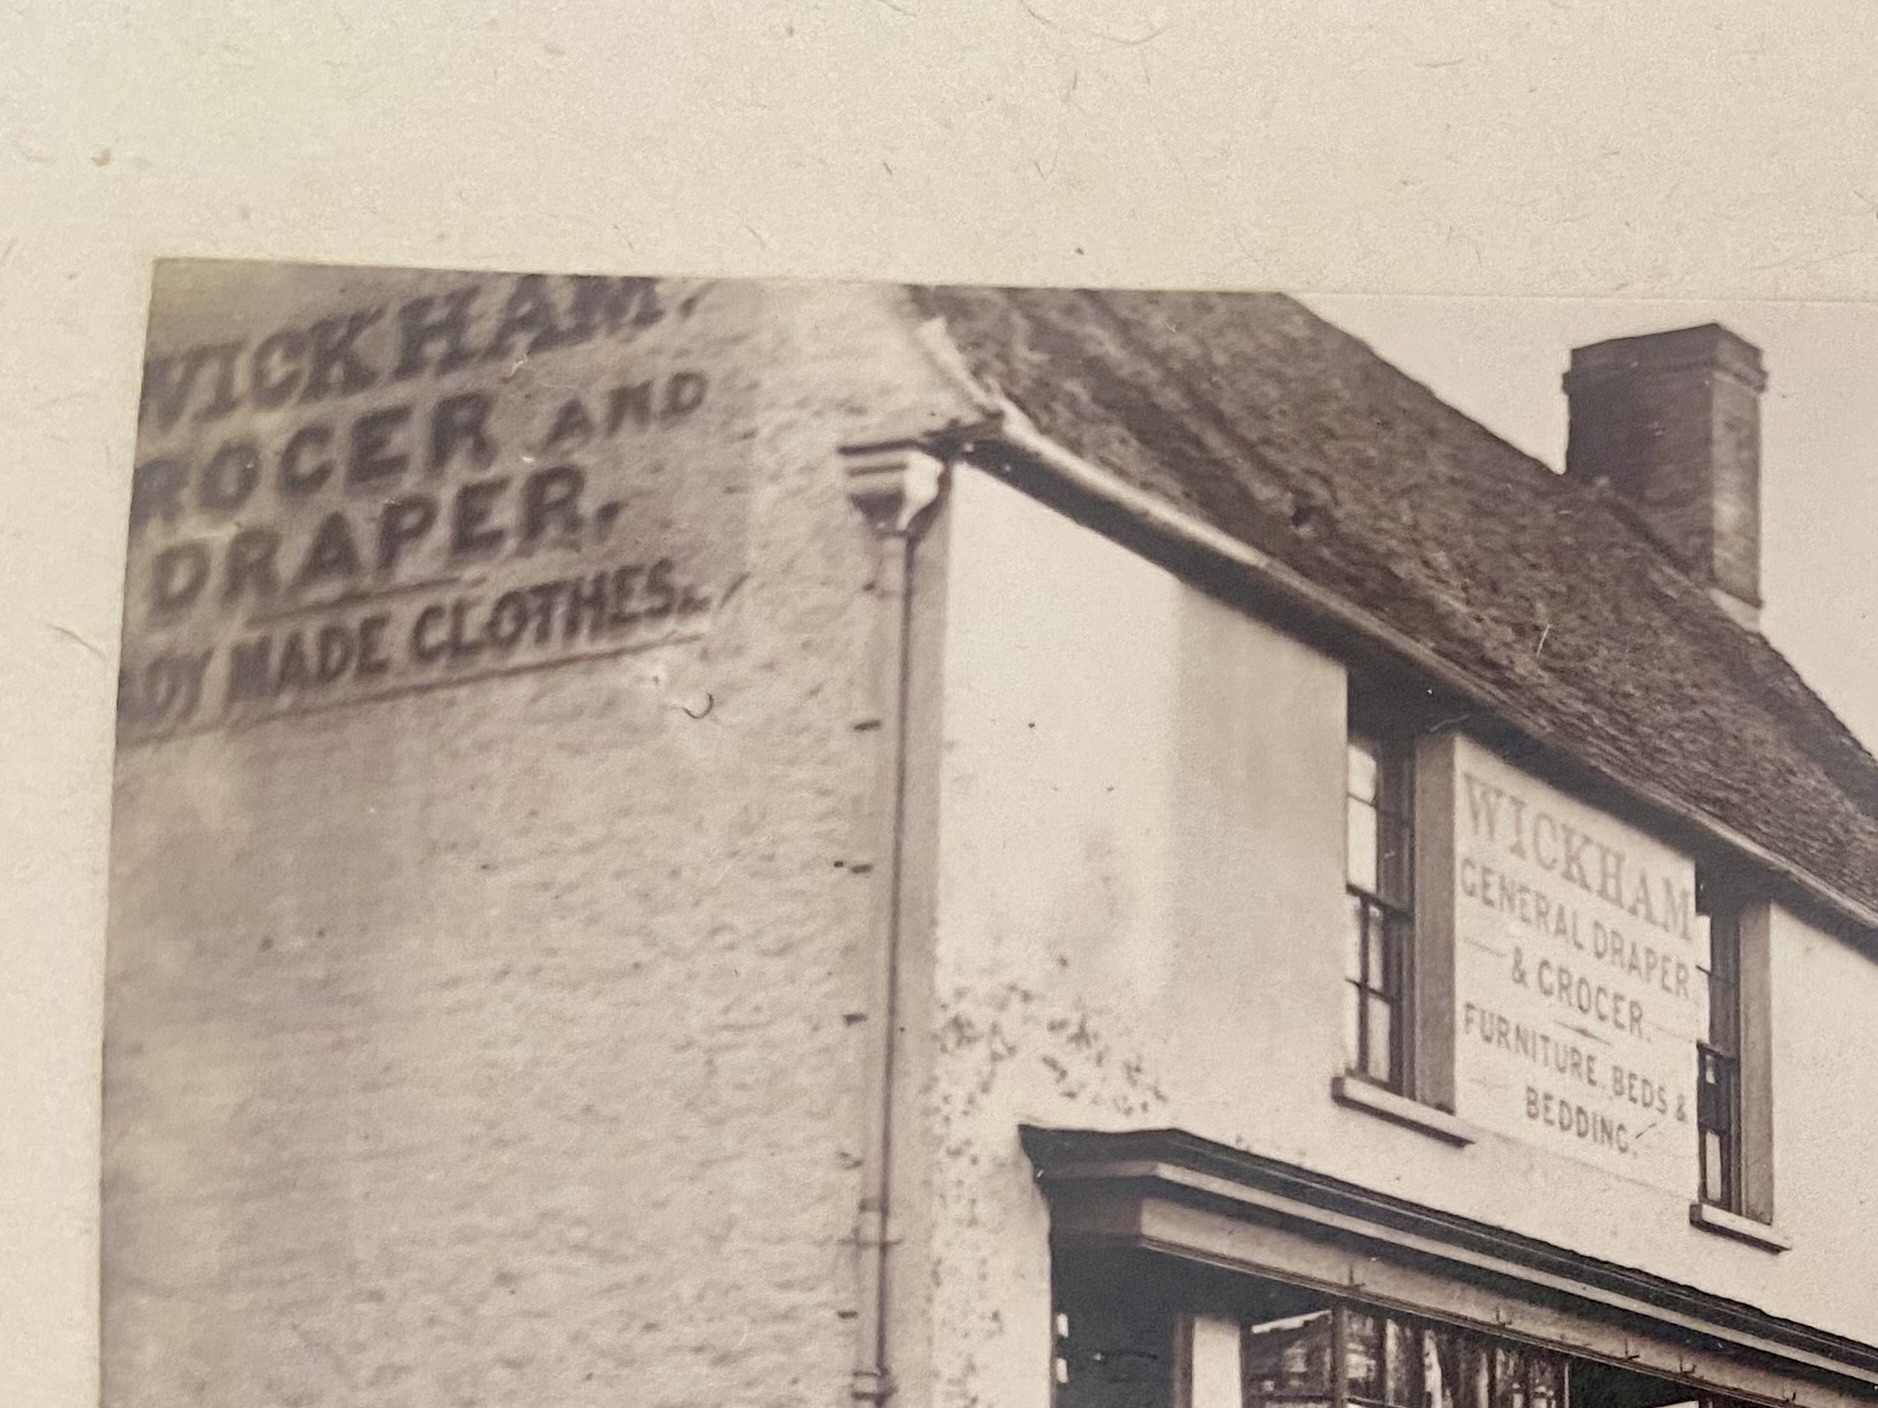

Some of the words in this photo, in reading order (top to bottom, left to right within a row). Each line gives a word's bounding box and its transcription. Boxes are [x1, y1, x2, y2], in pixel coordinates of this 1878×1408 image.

[542, 371, 708, 452] AND
[225, 614, 391, 703] MADE
[1463, 772, 1692, 942] WICKHAM
[1460, 857, 1584, 951] GENERAL
[1593, 918, 1689, 998] DRAPER
[1511, 945, 1528, 988] &
[1612, 1064, 1669, 1116] BEDS
